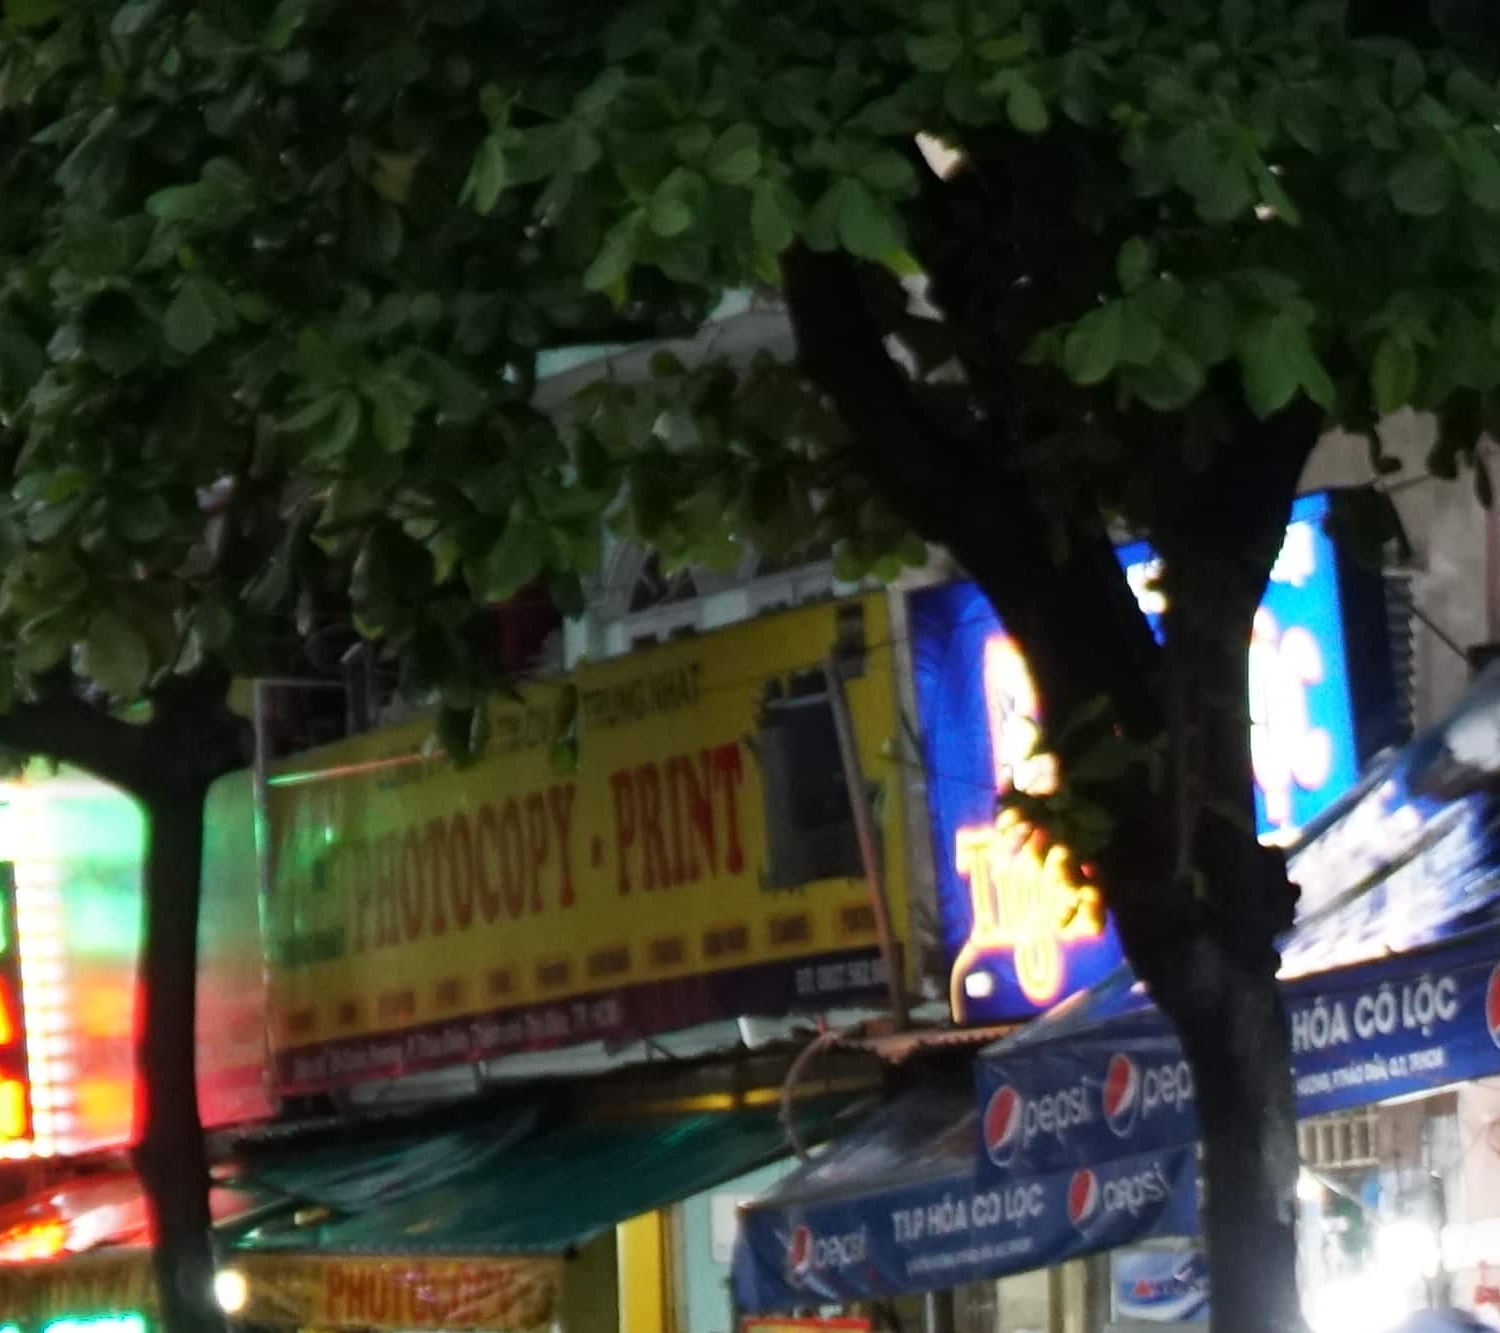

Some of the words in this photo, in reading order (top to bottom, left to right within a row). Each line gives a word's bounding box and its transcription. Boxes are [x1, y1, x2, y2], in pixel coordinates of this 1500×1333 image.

[353, 782, 577, 955] PHOTOCOPY
[607, 740, 743, 897] PRINT
[1290, 995, 1350, 1053] HÓA
[1354, 981, 1397, 1039] CÔ
[1402, 969, 1460, 1038] LỘC
[1025, 1077, 1092, 1148] pepsi
[1143, 1060, 1194, 1120] pep
